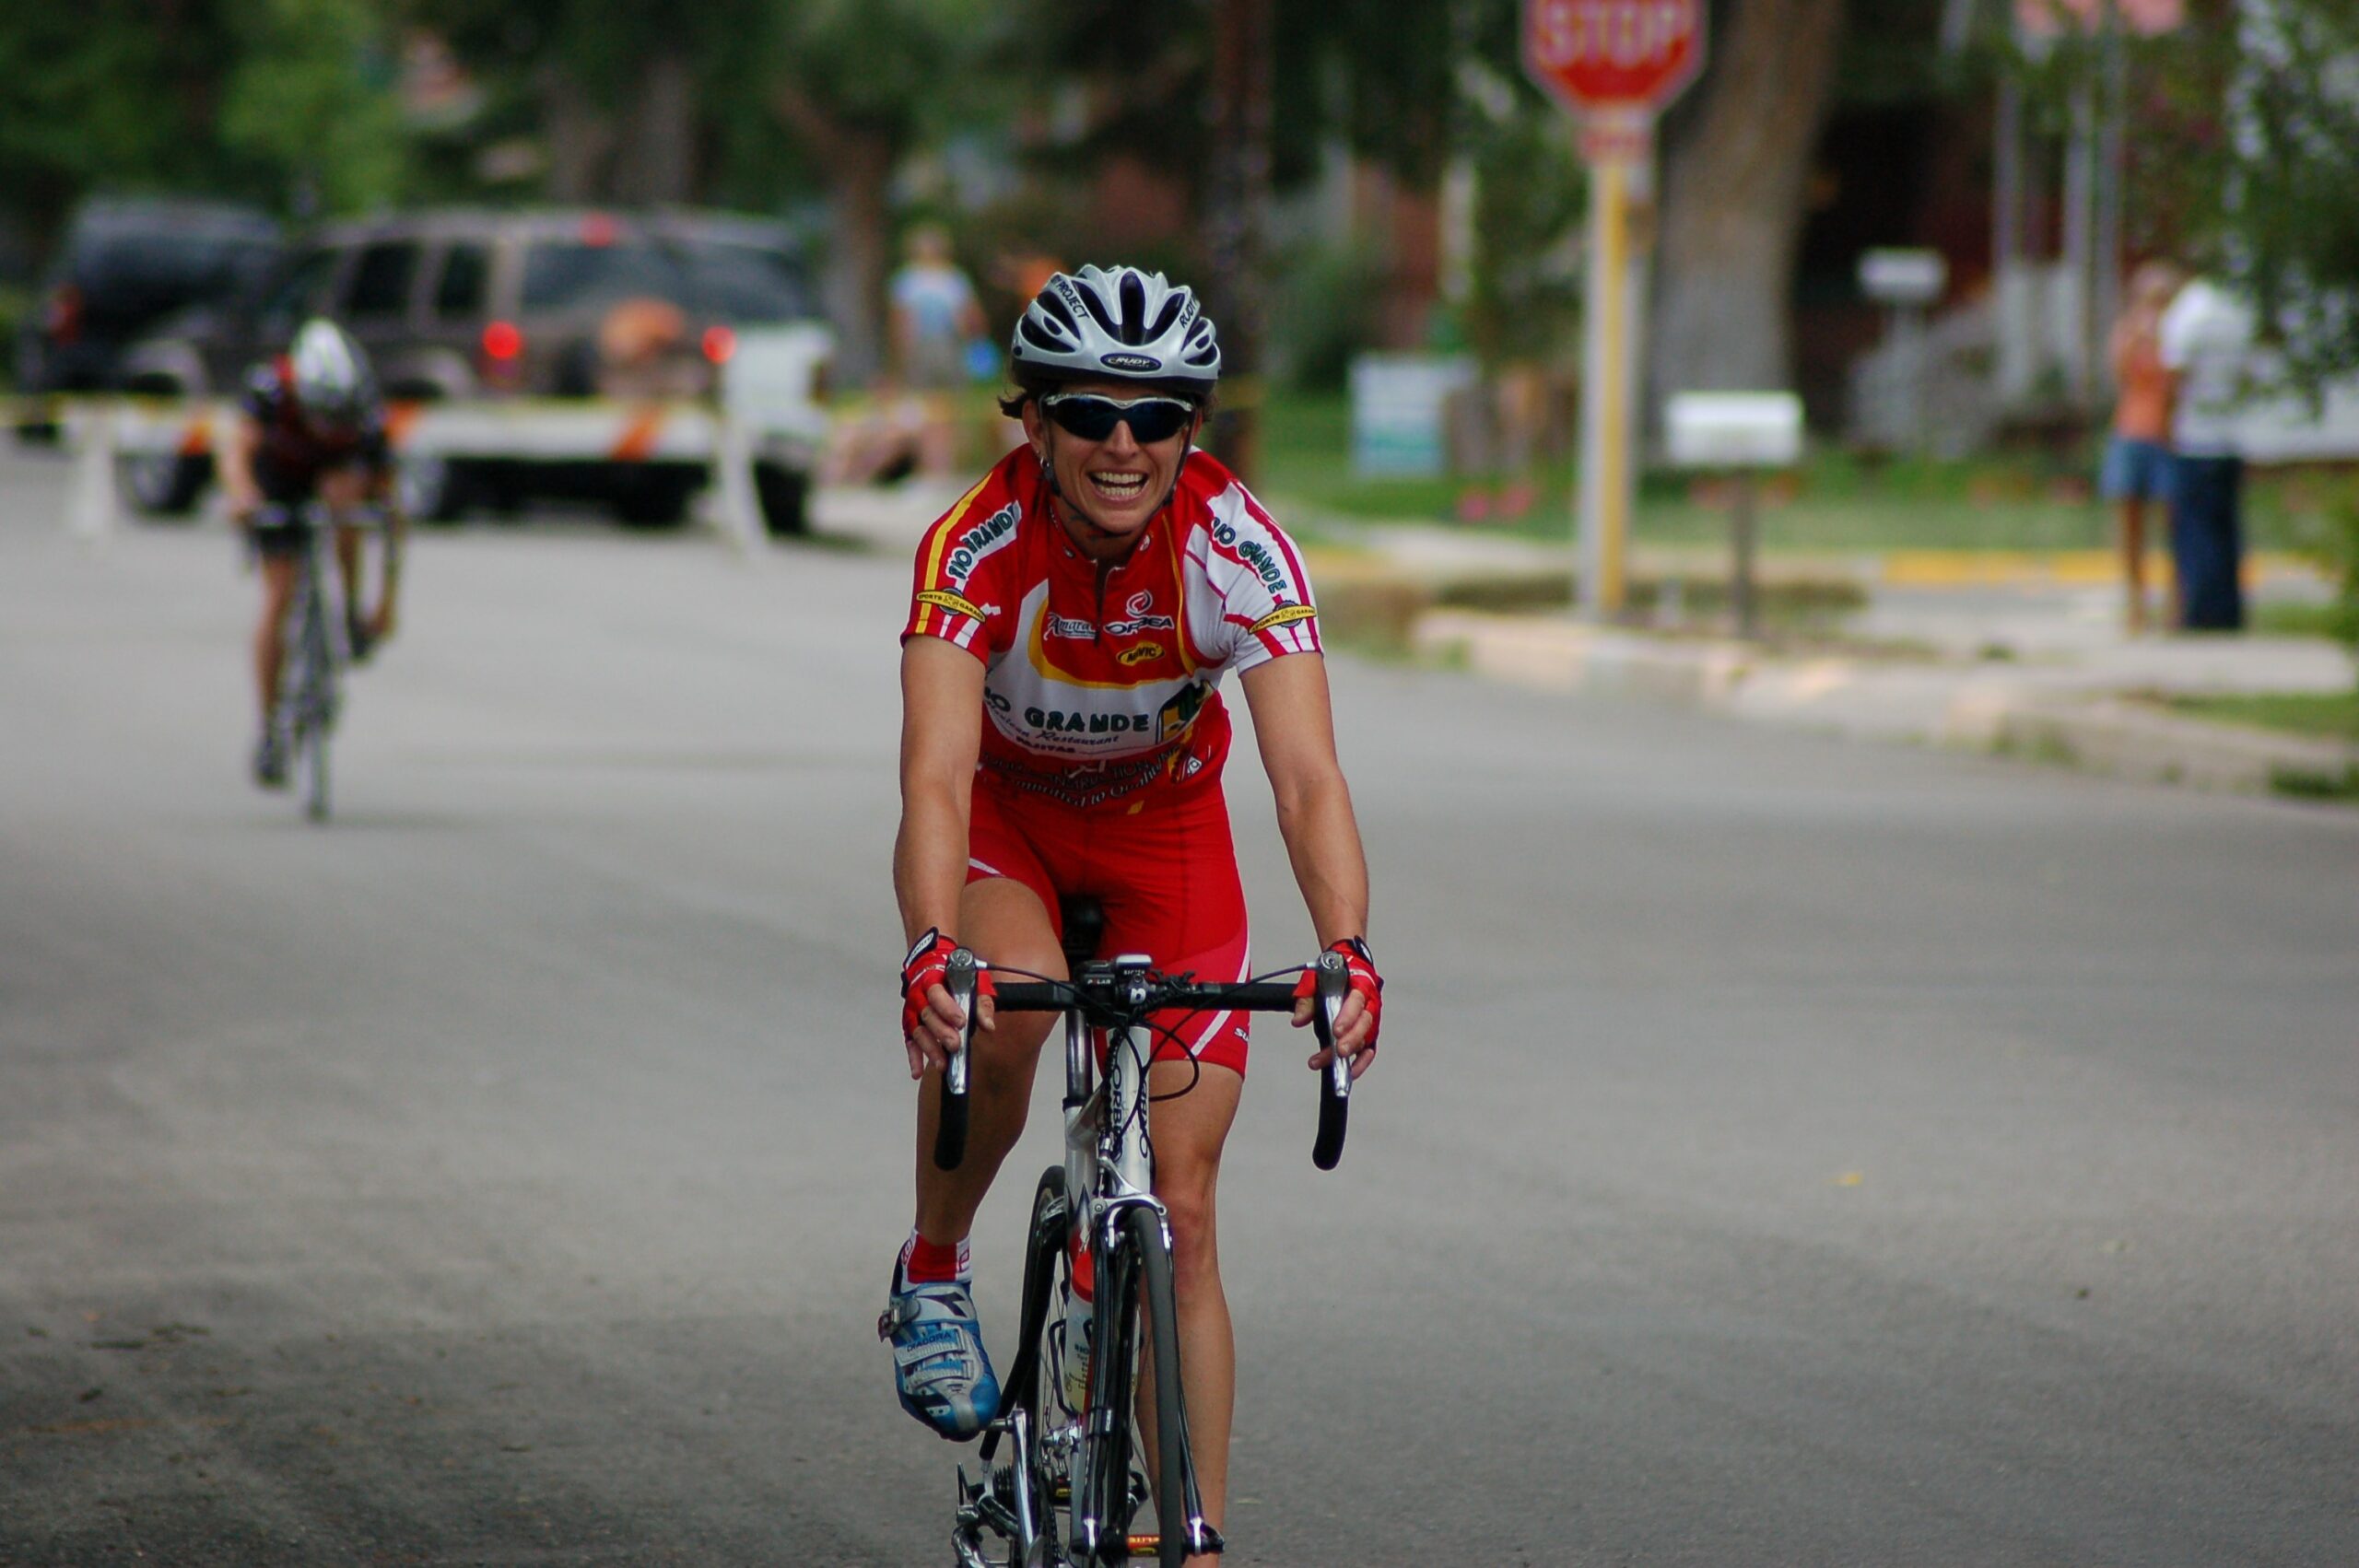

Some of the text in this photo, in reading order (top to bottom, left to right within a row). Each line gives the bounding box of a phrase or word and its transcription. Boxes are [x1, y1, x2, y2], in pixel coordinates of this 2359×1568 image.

[1537, 0, 1684, 65] STOP
[1057, 280, 1089, 319] PROJECT
[984, 686, 1150, 733] IO GRANDE
[1035, 729, 1120, 746] Restaurant
[907, 1332, 952, 1352] DIADORA
